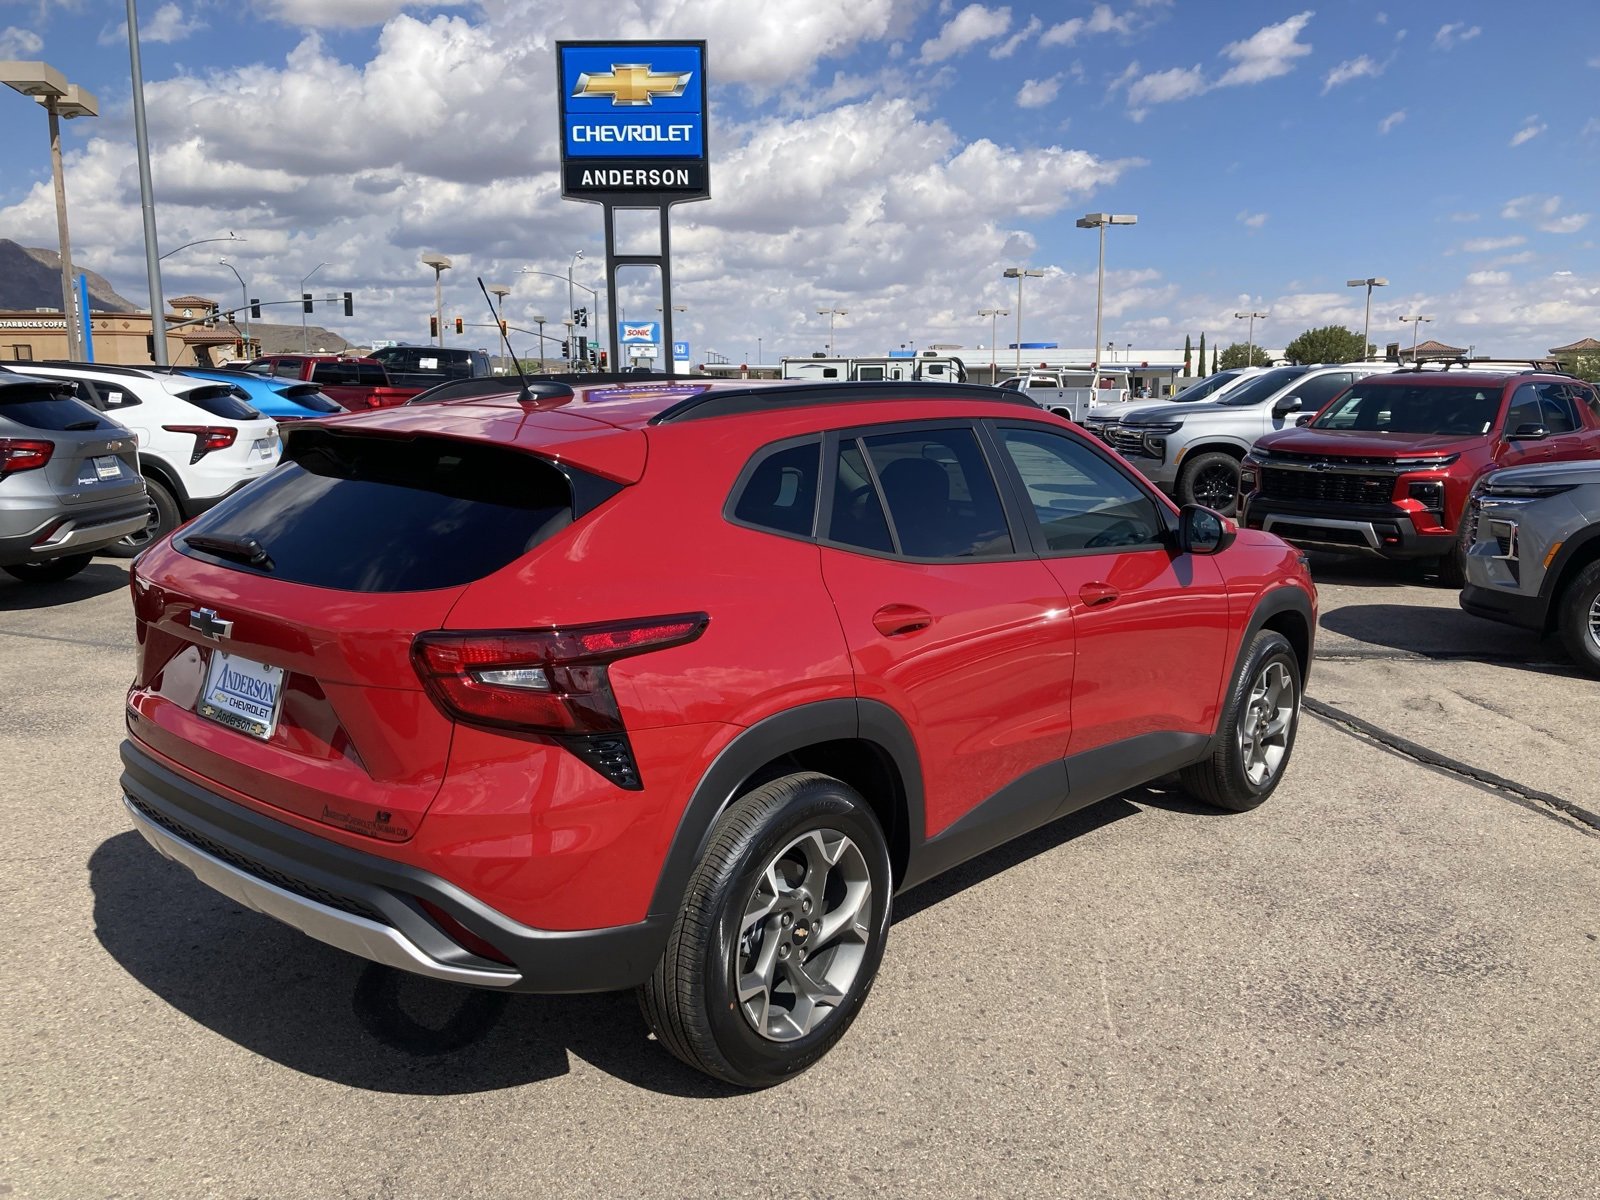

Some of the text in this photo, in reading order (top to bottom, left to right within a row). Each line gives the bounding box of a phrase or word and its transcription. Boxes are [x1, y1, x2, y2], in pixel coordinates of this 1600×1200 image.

[572, 124, 694, 142] CHEVROLET
[581, 169, 690, 186] ANDERSON
[208, 663, 277, 703] ANDERSON
[229, 697, 270, 719] CHEVROLET
[215, 708, 251, 732] Anderson
